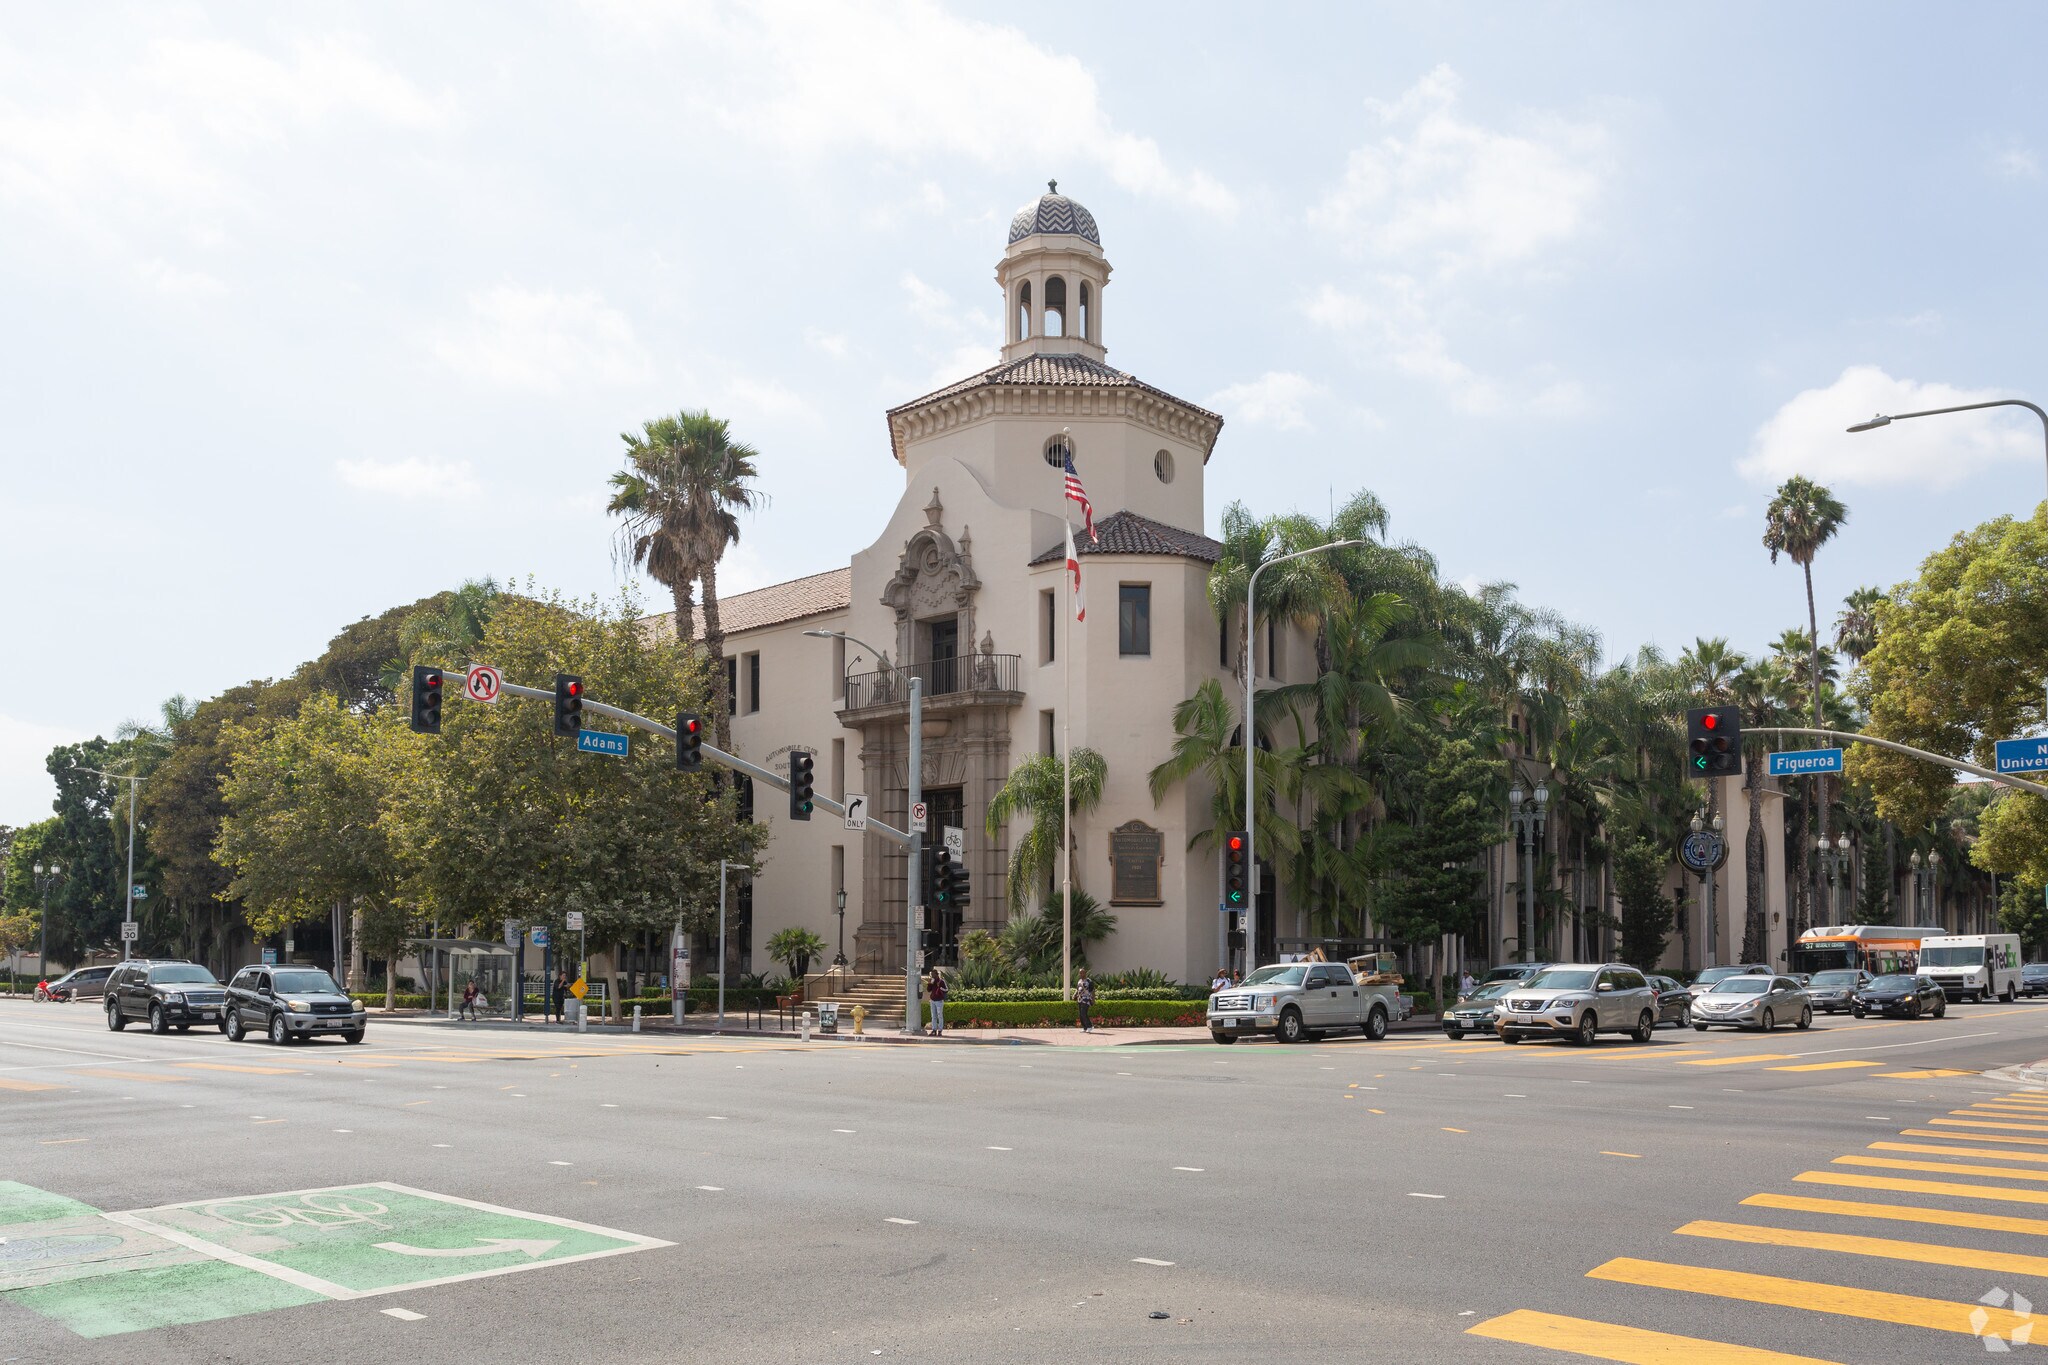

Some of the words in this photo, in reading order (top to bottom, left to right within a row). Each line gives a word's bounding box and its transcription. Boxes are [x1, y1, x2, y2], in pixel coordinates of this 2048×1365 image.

[583, 735, 623, 751] Adams
[765, 745, 801, 762] AUTOMOBILE
[1777, 756, 1835, 773] Figueroa
[847, 819, 864, 828] ONLY
[949, 848, 962, 857] GNAL
[124, 931, 136, 939] 30
[1994, 943, 2017, 970] FedEx
